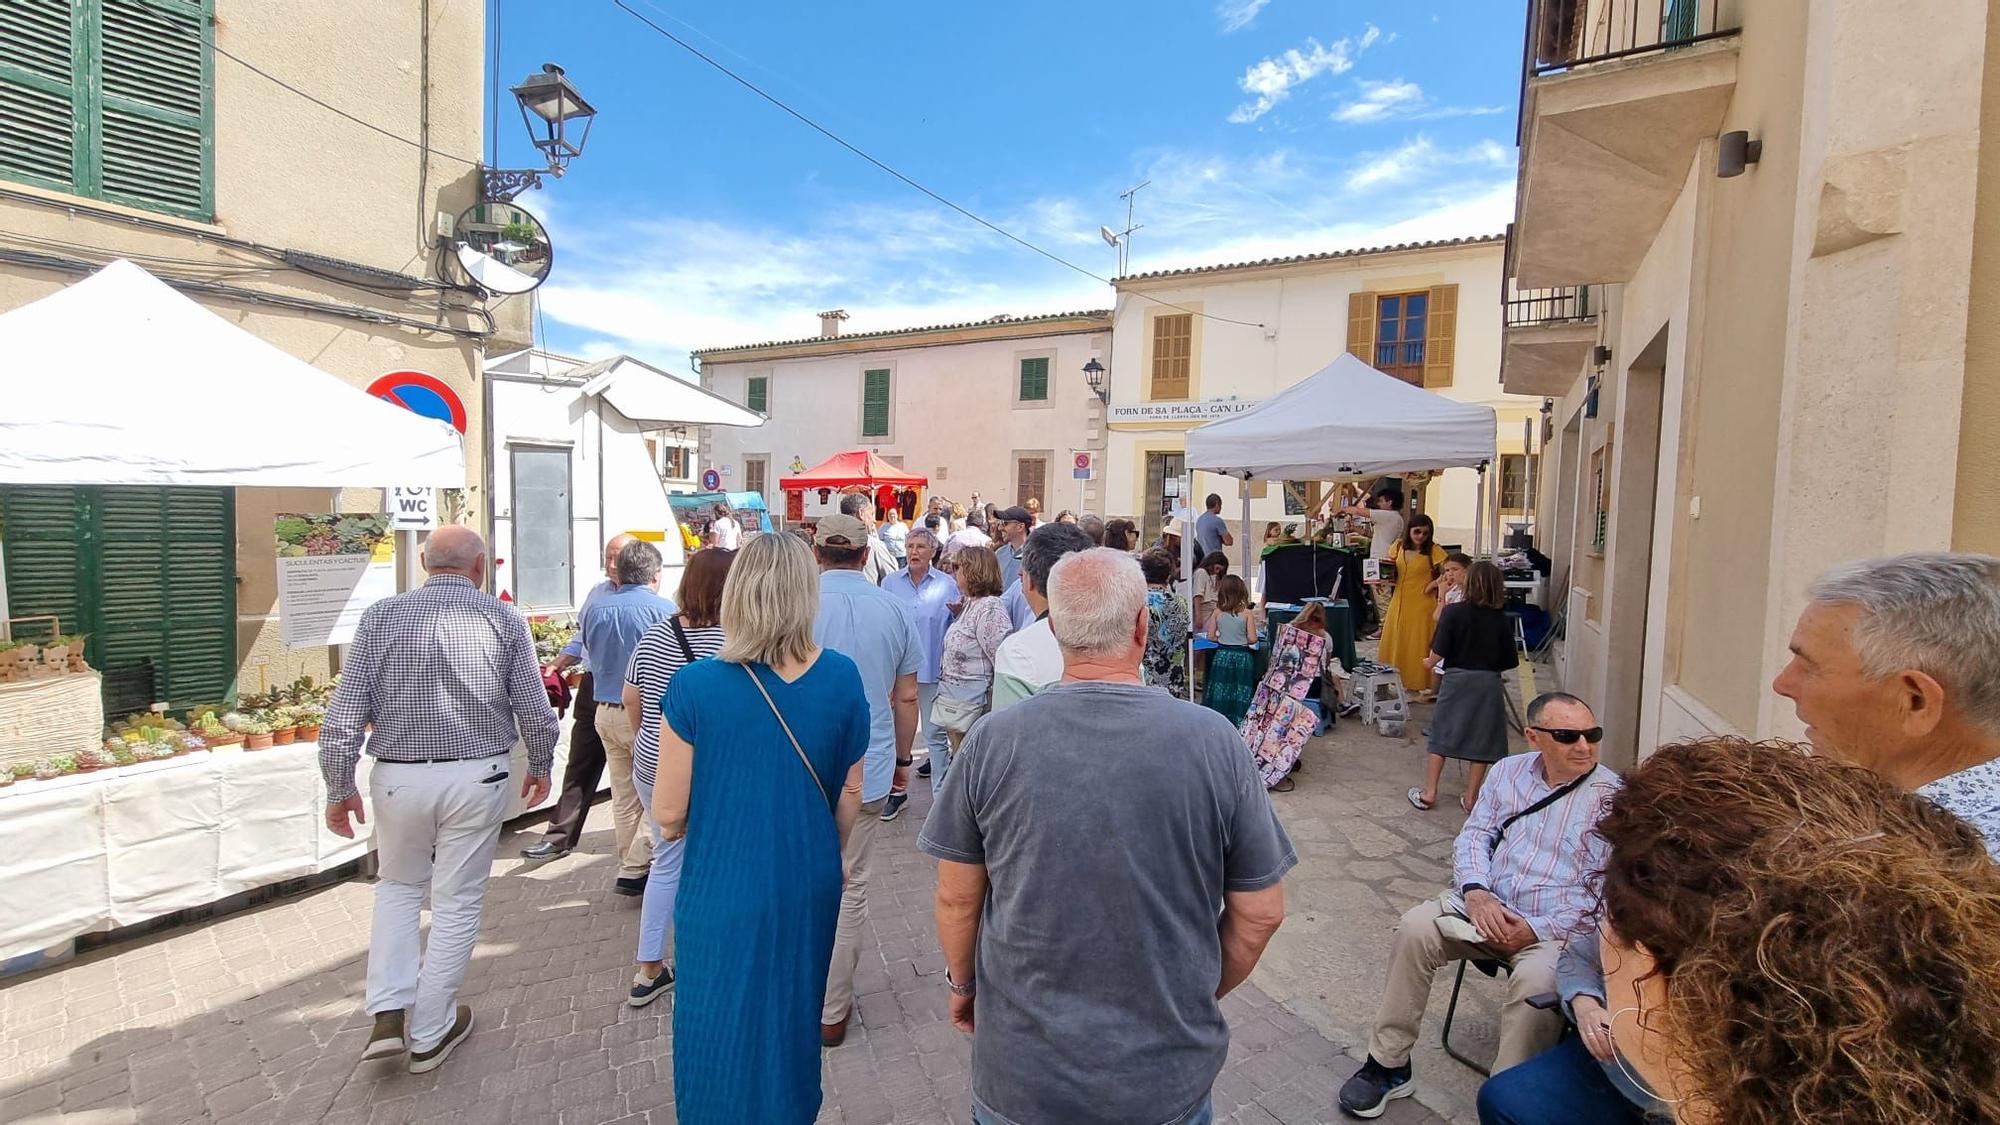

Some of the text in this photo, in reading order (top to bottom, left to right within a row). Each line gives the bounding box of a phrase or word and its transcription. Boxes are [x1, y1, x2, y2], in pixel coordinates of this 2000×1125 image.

[1115, 407, 1139, 416] FORN
[1141, 407, 1154, 415] DE
[1155, 407, 1167, 415] SA
[1171, 406, 1202, 415] PLAÇA
[399, 499, 428, 512] WC
[286, 559, 333, 567] SUCULENTAS
[338, 557, 367, 565] CACTUS
